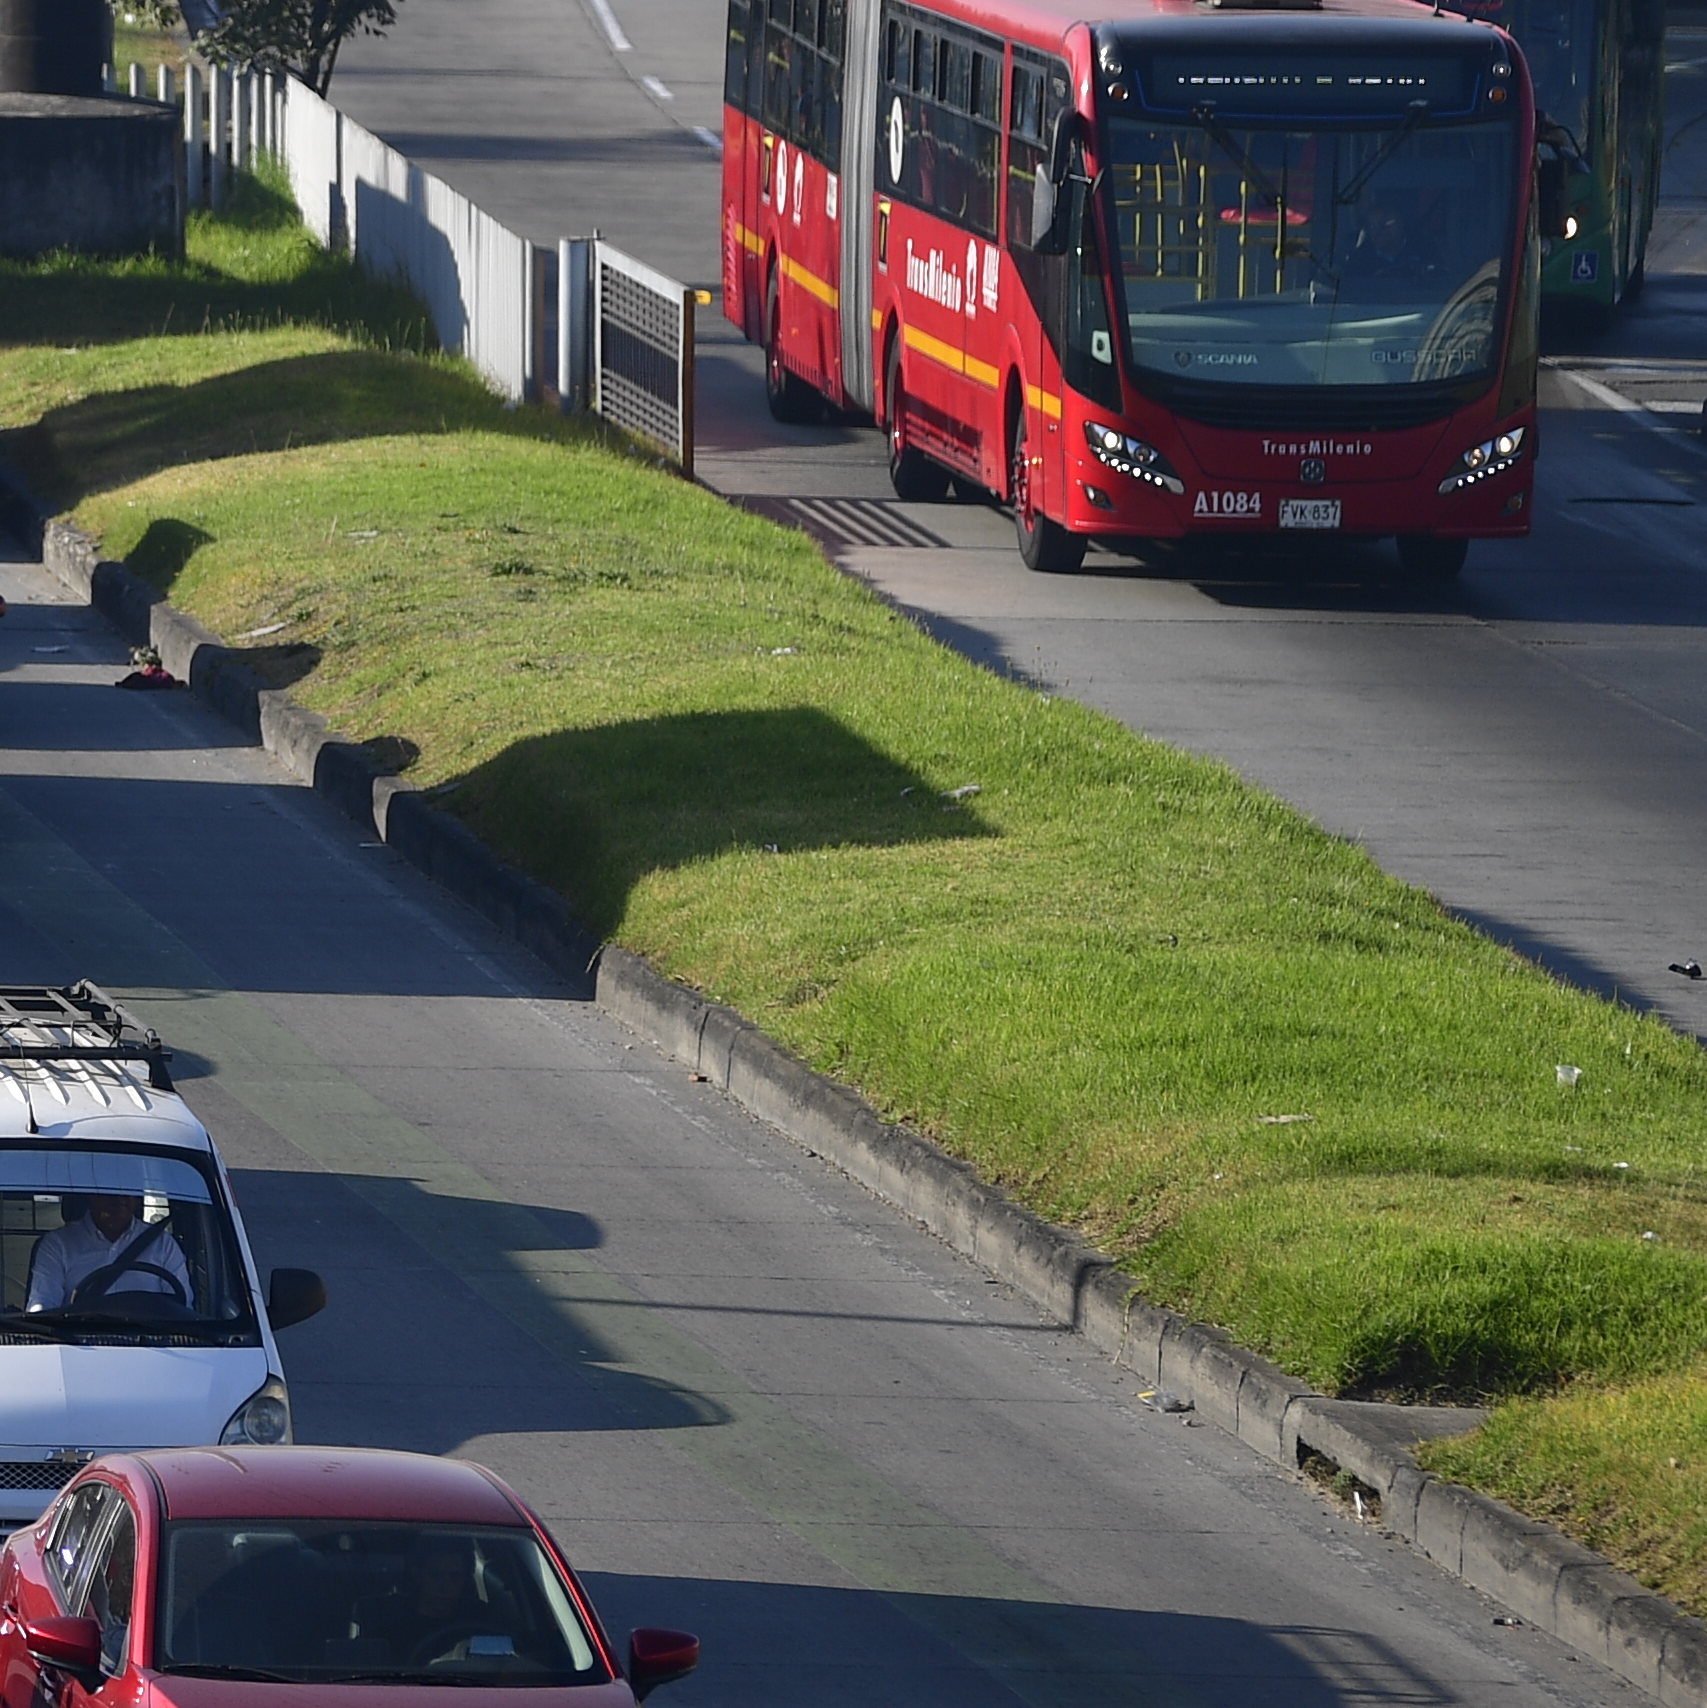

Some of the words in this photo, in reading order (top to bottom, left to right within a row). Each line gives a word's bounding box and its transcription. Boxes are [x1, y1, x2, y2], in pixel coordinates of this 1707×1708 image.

[1198, 353, 1258, 366] SCANIA
[1262, 440, 1372, 455] TransMilenio
[1194, 491, 1261, 513] A1084
